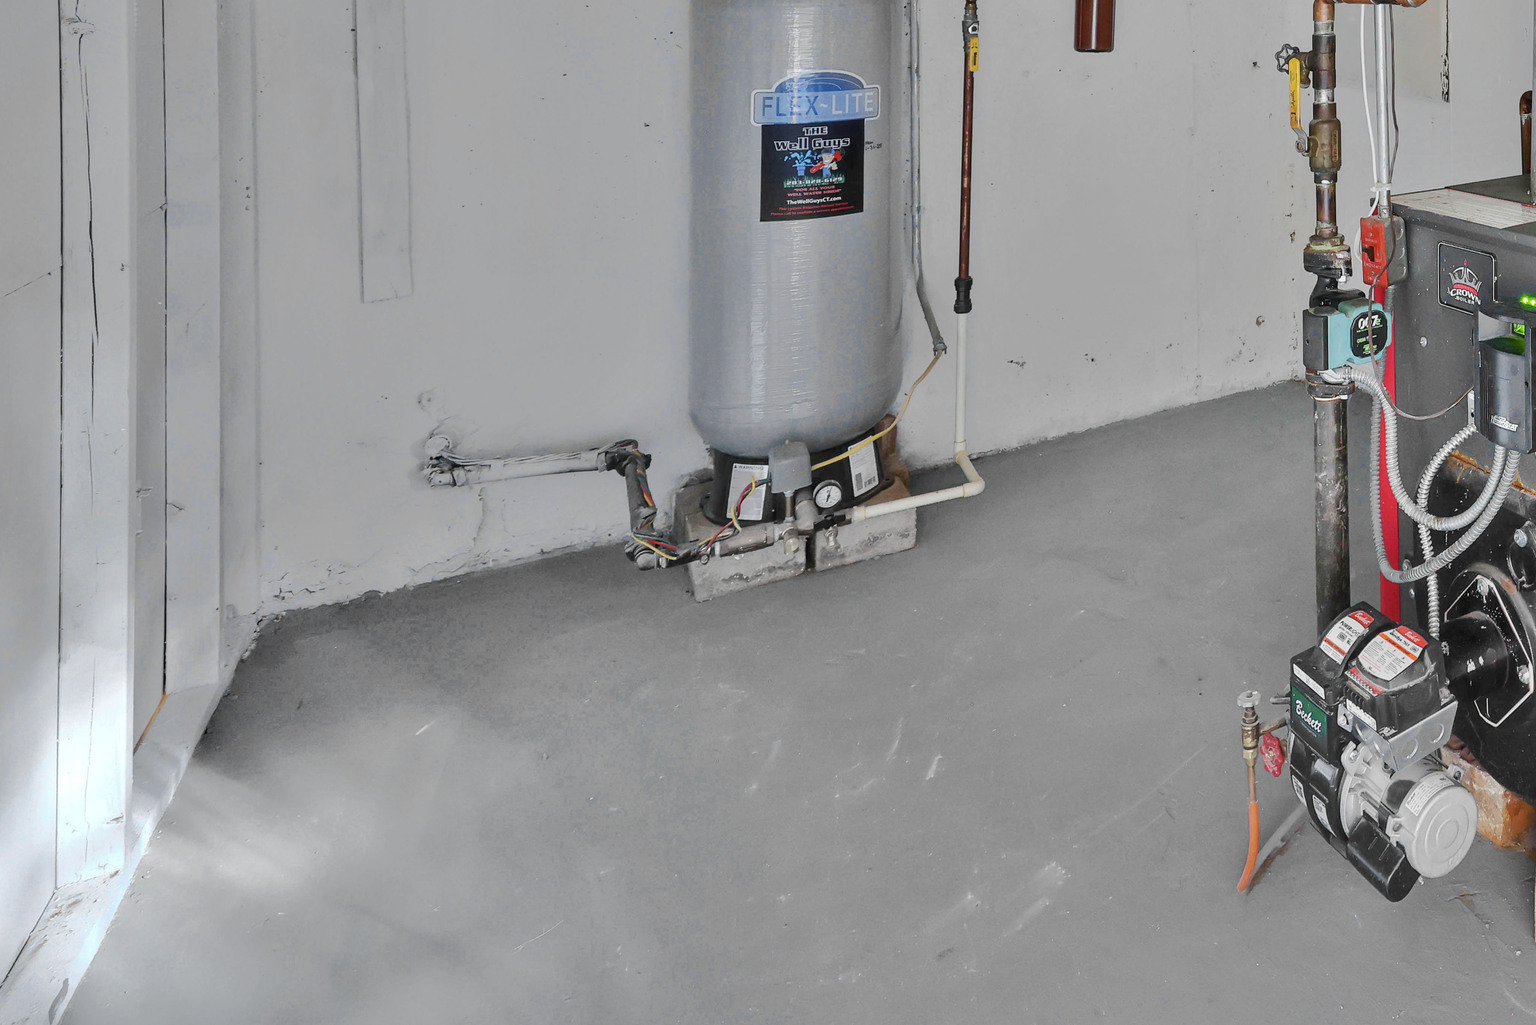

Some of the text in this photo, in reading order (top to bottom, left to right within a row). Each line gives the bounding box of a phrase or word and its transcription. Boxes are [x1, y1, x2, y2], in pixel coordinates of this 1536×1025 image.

[803, 126, 828, 136] THE
[774, 137, 850, 151] Well Guys
[787, 196, 842, 205] TheWellGuysCT.com
[1450, 288, 1481, 305] CROWN
[1296, 700, 1321, 732] Beckett
